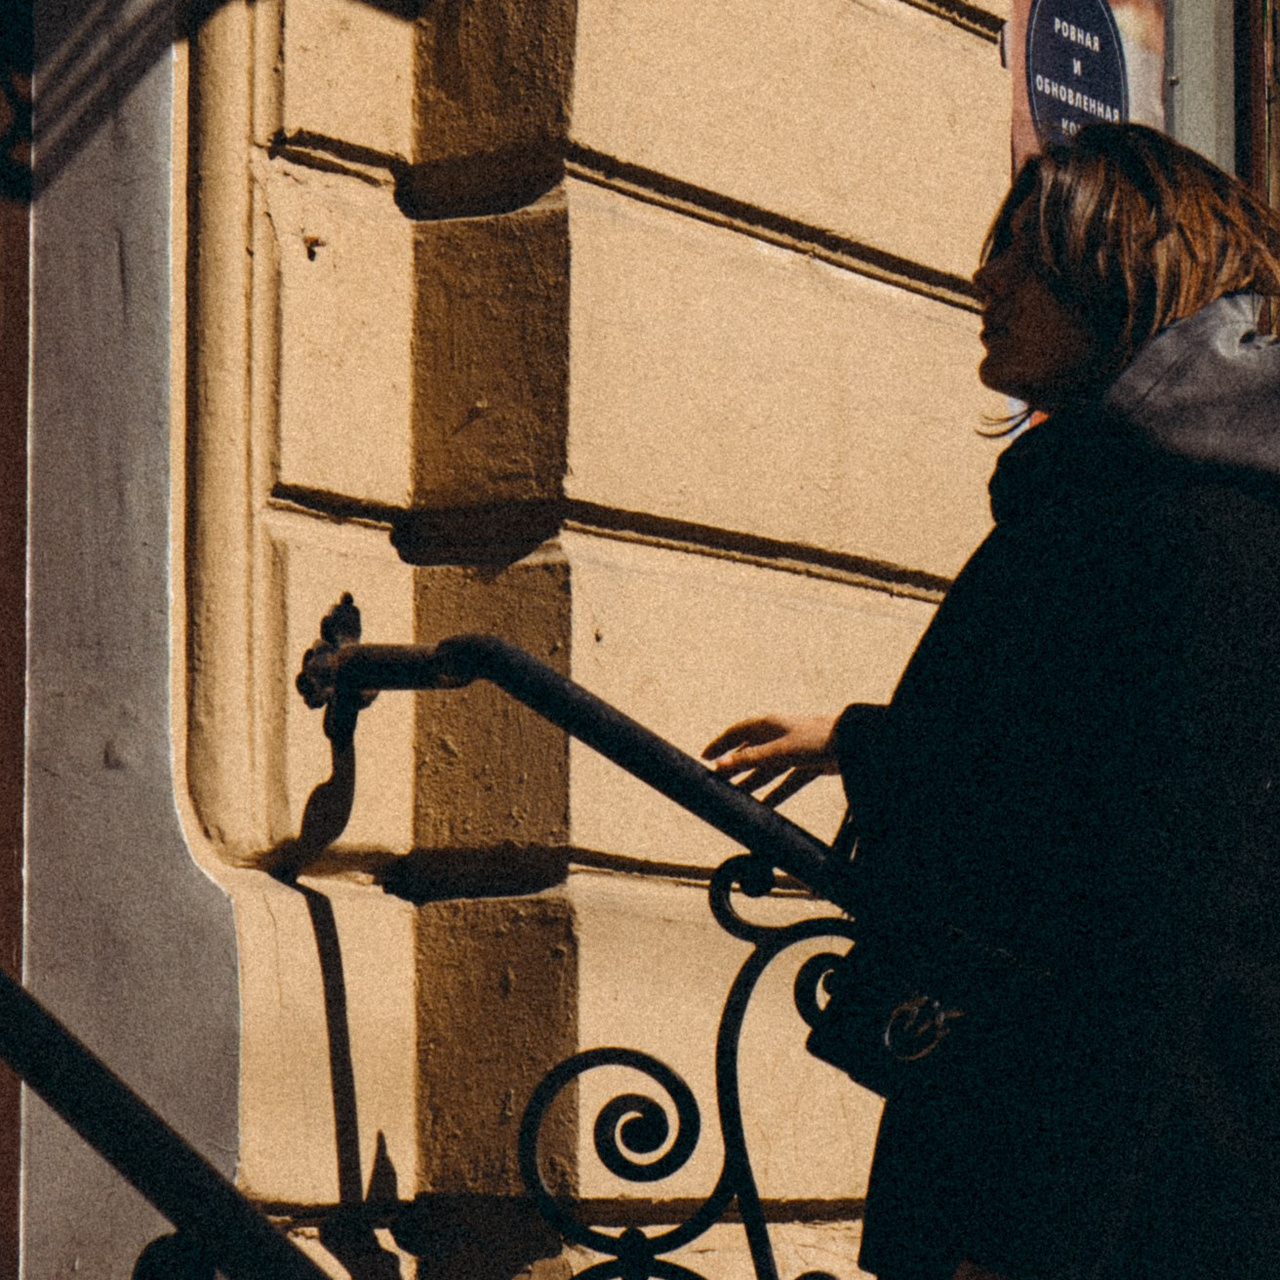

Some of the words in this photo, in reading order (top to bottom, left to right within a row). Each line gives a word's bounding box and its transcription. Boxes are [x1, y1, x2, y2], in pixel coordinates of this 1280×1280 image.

[1054, 17, 1101, 53] РОВНАЯ
[1072, 57, 1083, 77] И
[1035, 73, 1120, 125] ОБНОВЛЕННАЯ
